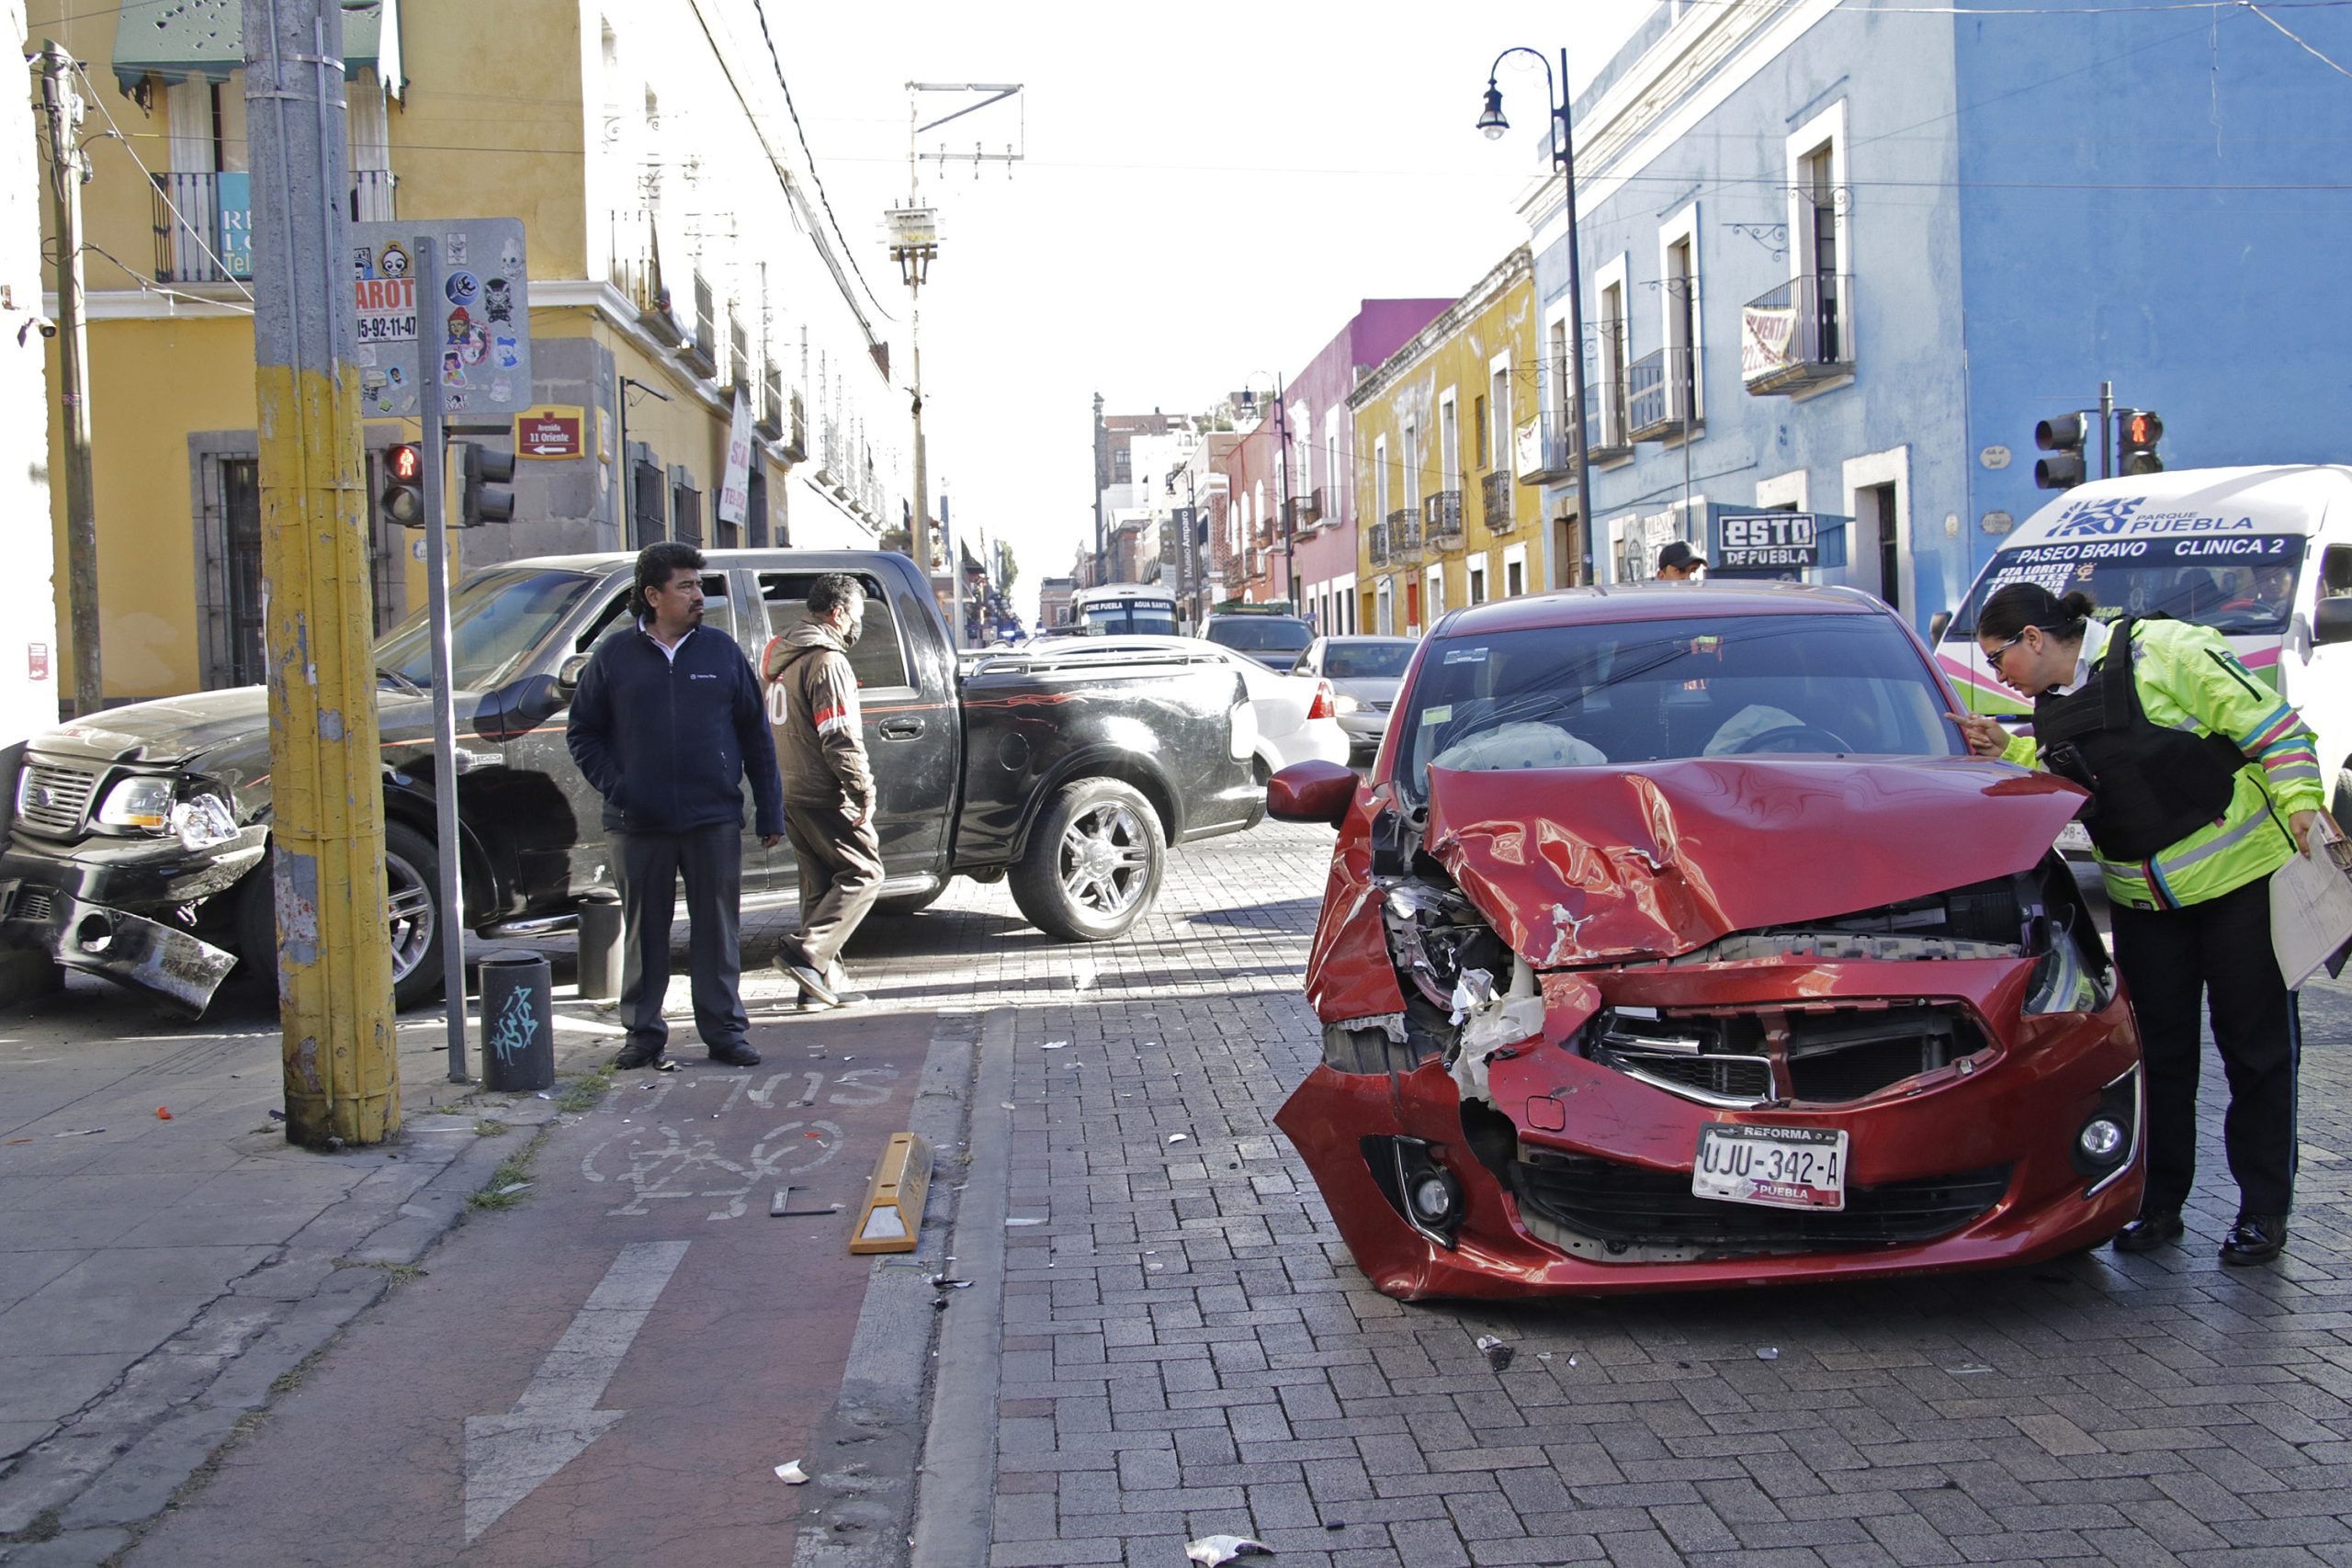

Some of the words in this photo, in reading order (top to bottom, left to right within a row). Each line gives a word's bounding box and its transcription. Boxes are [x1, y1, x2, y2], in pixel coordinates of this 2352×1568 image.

[356, 279, 414, 309] AROT
[537, 423, 560, 432] Avenida
[530, 434, 539, 442] 11
[540, 433, 569, 442] Oriente
[2136, 512, 2199, 521] PARQUE
[1182, 510, 1192, 547] Amparo
[2130, 517, 2254, 534] PUEBLA
[1726, 552, 1745, 565] DE
[1748, 549, 1809, 565] PUEBLA
[2017, 546, 2079, 564] PASEO
[2079, 542, 2148, 559] BRAVO
[2174, 539, 2263, 556] CLINICA
[2268, 538, 2285, 554] 2
[1183, 548, 1193, 579] Museo
[1997, 568, 2026, 578] PZA
[2024, 563, 2075, 575] LORETO
[1101, 602, 1123, 610] PUEBLA
[1151, 602, 1170, 610] SANTA
[1744, 1127, 1811, 1141] REFORMA
[1703, 1143, 1837, 1186] UJU-342-A
[1759, 1185, 1808, 1199] PUEBLA
